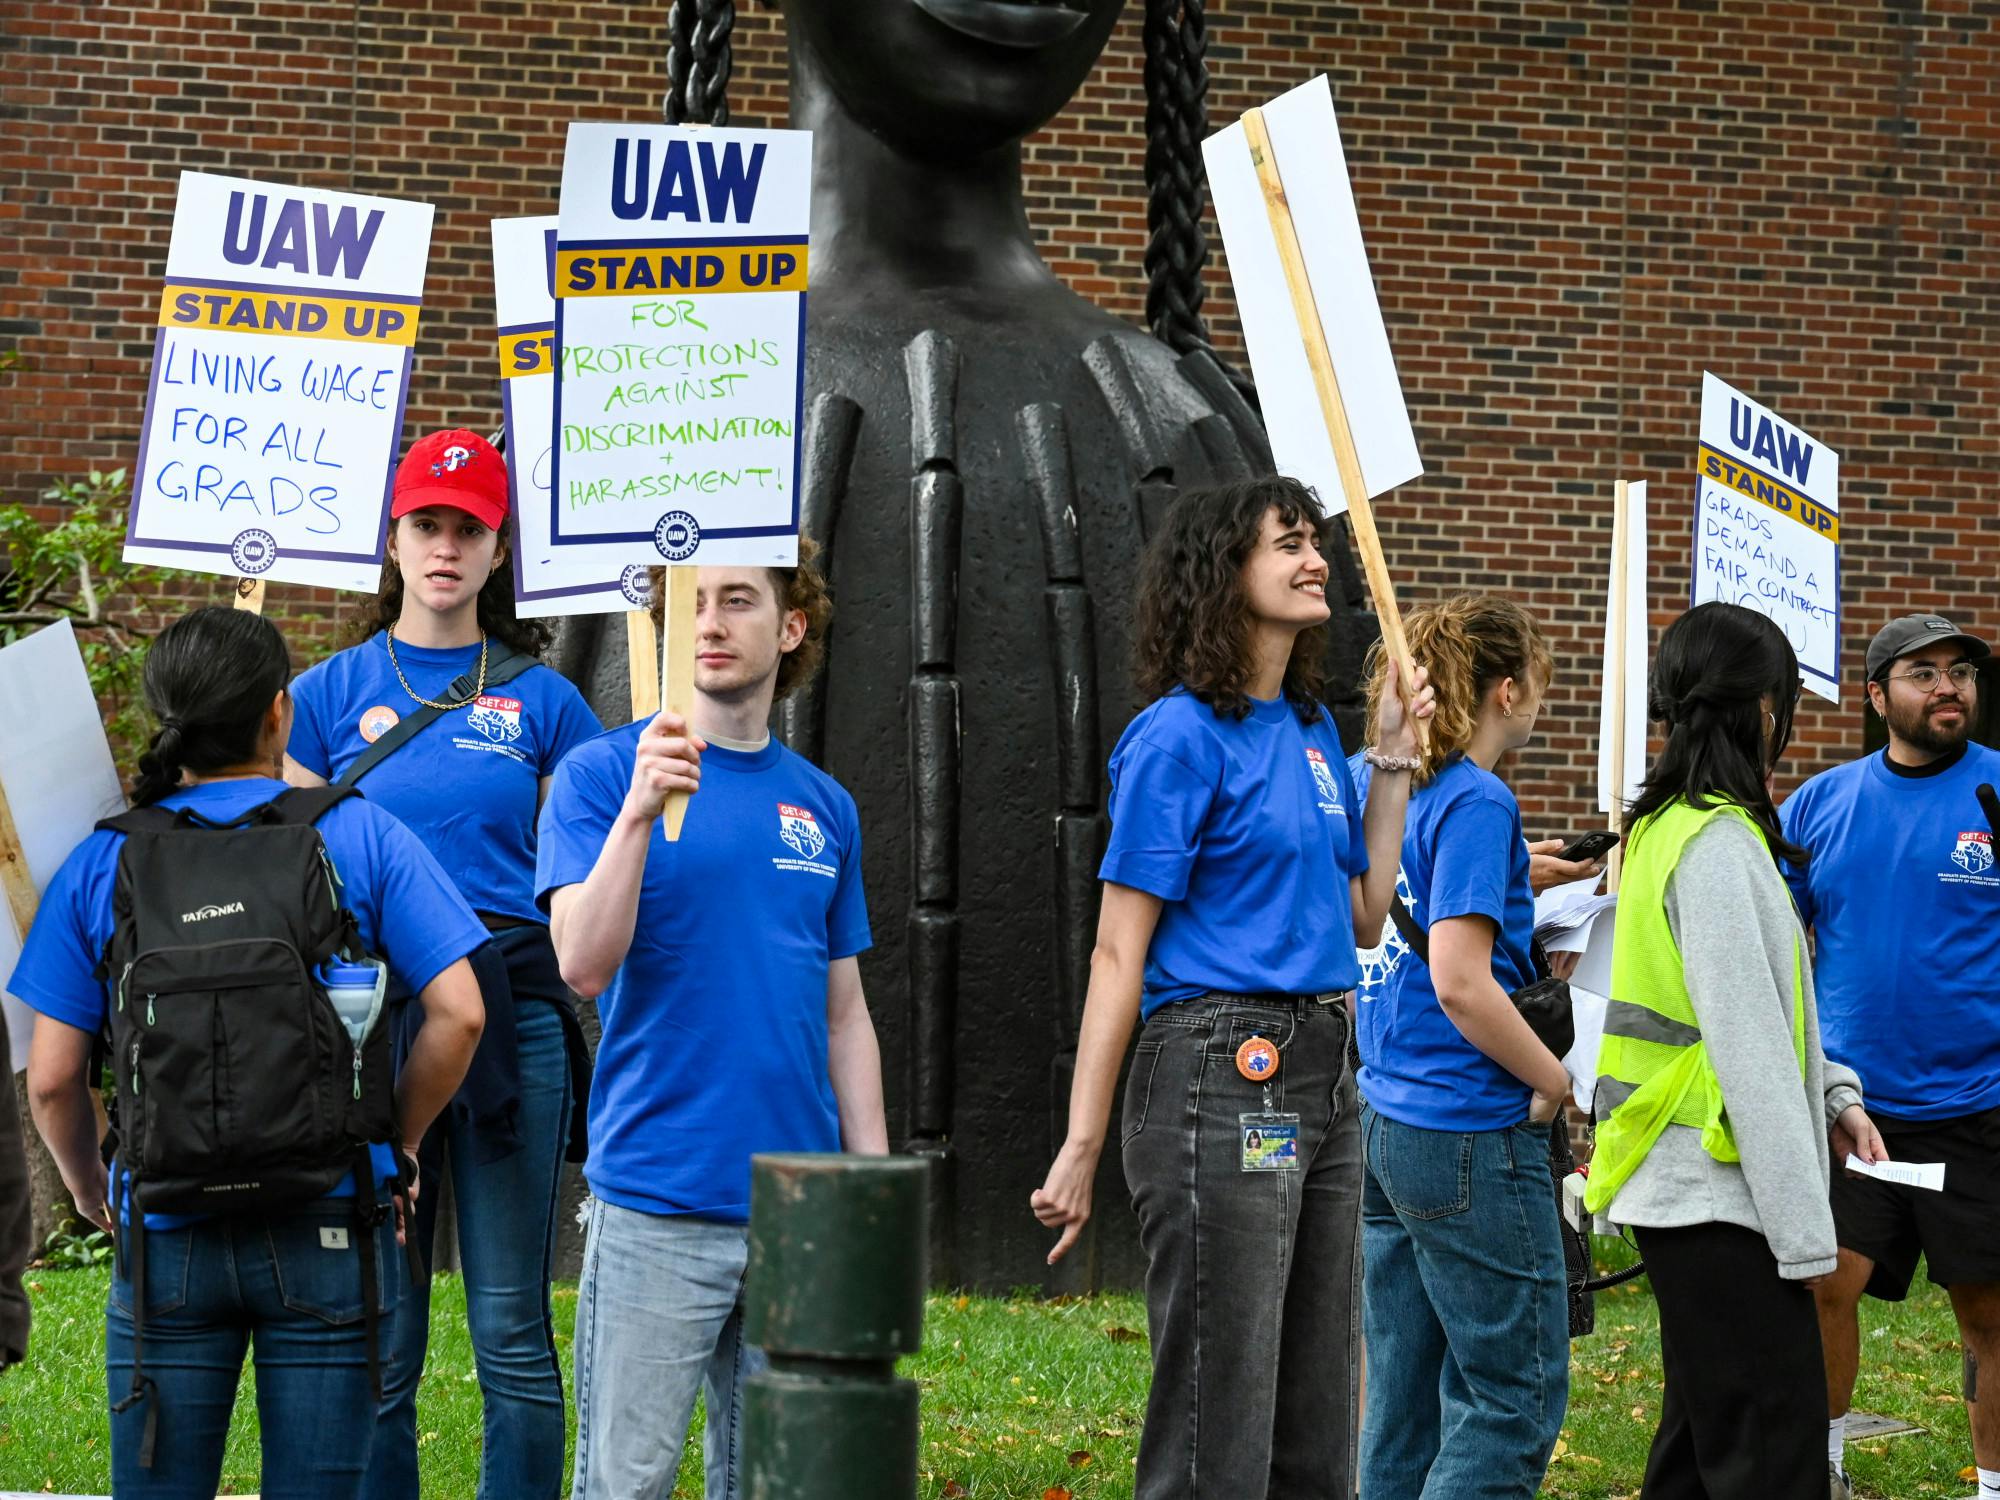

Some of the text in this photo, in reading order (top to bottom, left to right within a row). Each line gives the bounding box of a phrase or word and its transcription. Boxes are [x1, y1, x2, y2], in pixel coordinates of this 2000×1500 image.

[611, 138, 768, 224] UAW
[222, 190, 385, 281] UAW
[568, 254, 725, 291] STAND
[740, 252, 796, 287] UP
[171, 292, 406, 339] STAND UP
[631, 300, 709, 331] FOR
[163, 341, 394, 409] LIVING WAGE
[561, 338, 779, 383] PROTECTIONS
[603, 373, 749, 412] AGAINST
[172, 407, 343, 469] FOR ALL
[563, 416, 792, 454] DISCRIMINATION
[1729, 396, 1814, 487] UAW
[156, 461, 341, 535] GRADS
[569, 467, 784, 510] HARASSMENT!
[1705, 455, 1832, 533] STAND UP
[667, 530, 686, 541] UAW
[1705, 490, 1773, 541] GRADS
[245, 545, 263, 557] UAW
[1706, 518, 1819, 595] DEMAND A
[1705, 546, 1836, 629] FAIR CONTRACT
[478, 697, 519, 710] GET-UP
[781, 805, 812, 819] GET-UP
